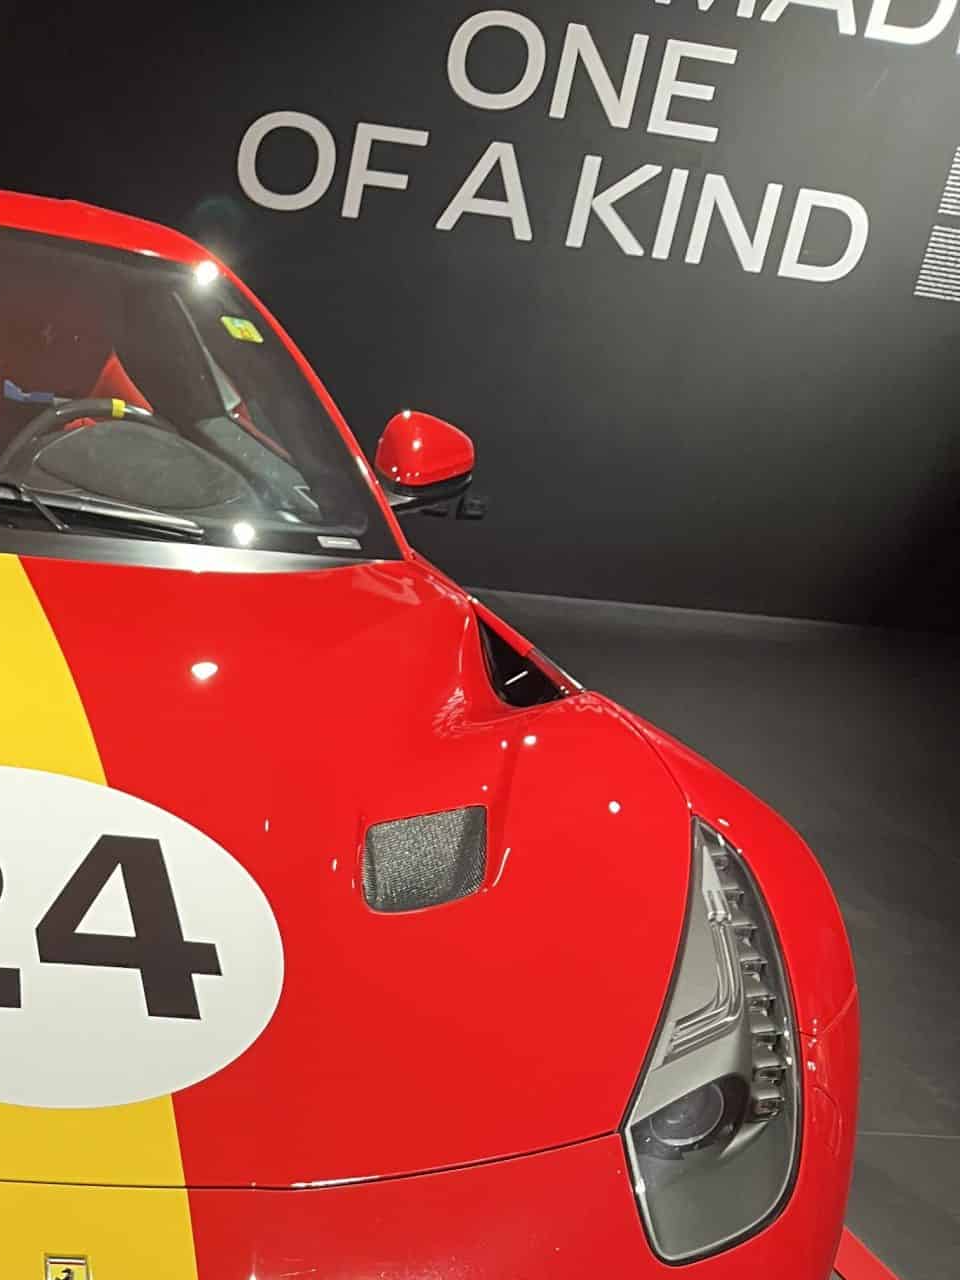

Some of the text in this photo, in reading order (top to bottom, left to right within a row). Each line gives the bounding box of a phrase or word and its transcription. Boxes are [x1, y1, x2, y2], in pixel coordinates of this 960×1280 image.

[447, 10, 737, 142] ONE
[237, 111, 869, 281] OF A KIND
